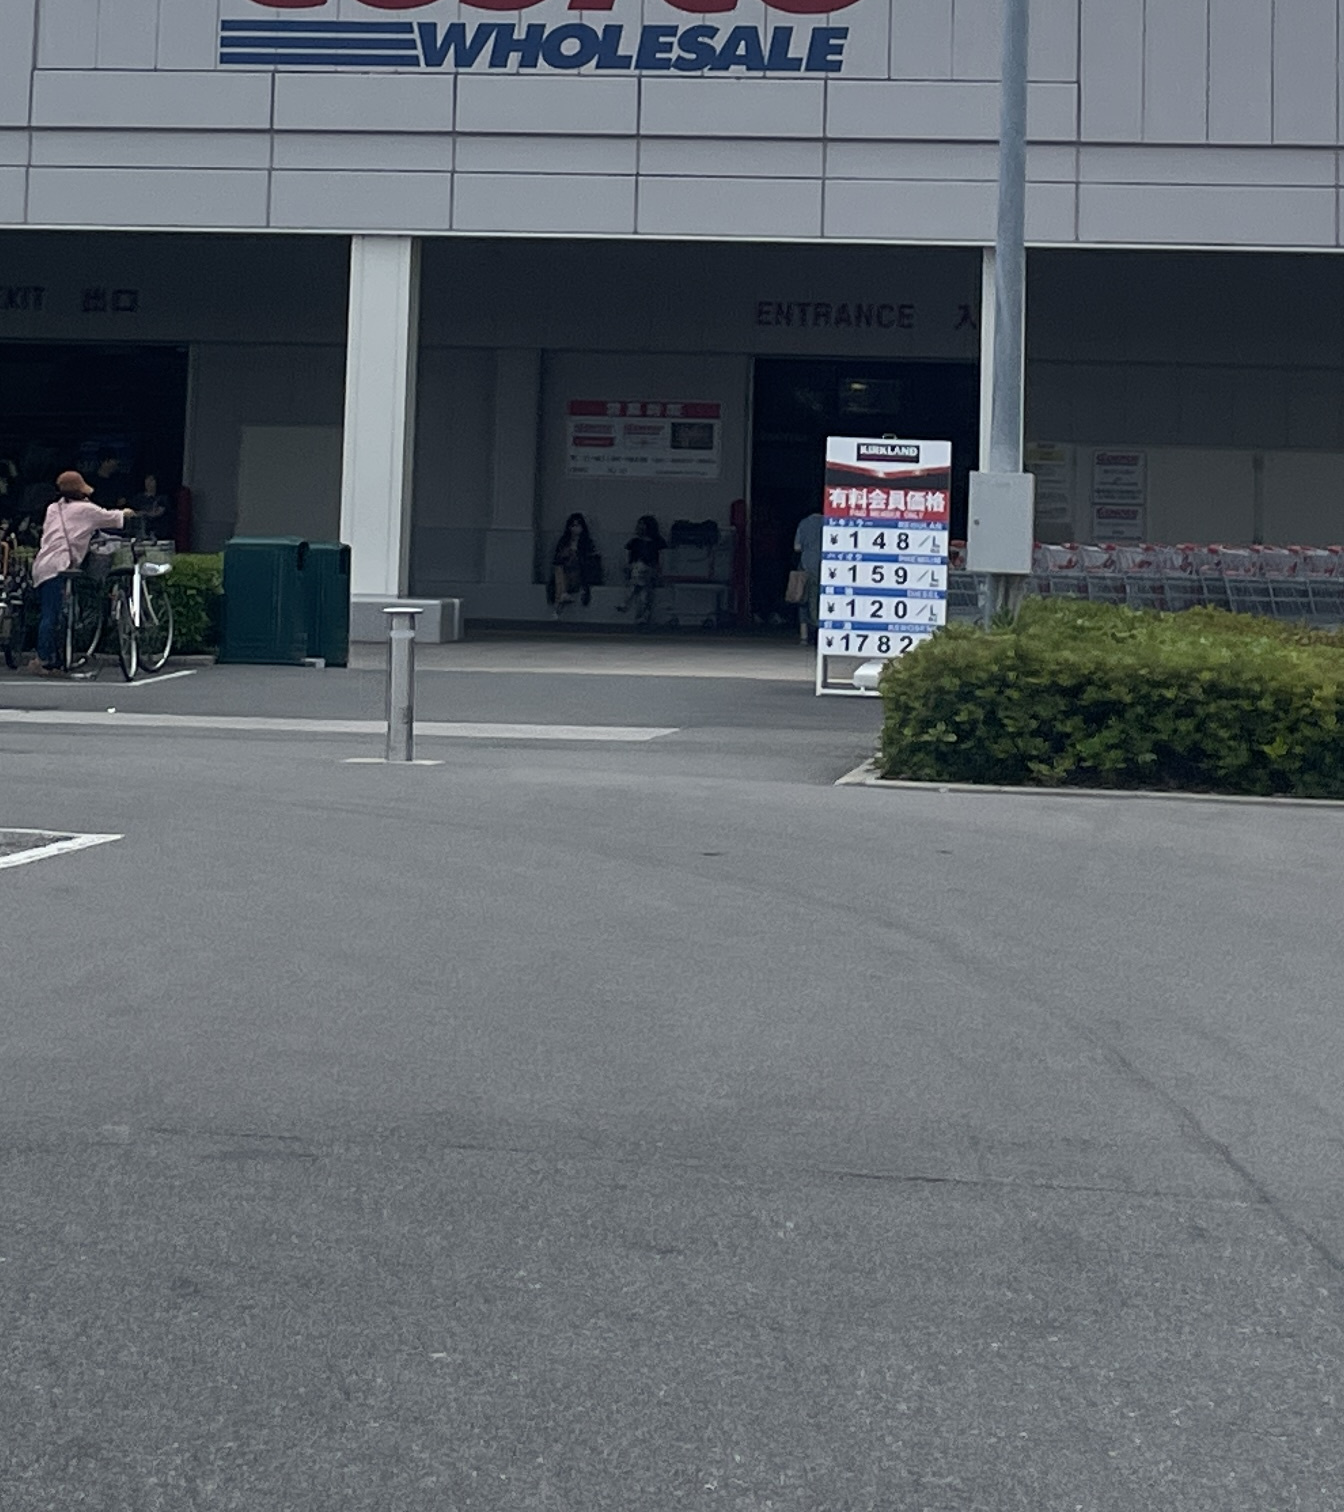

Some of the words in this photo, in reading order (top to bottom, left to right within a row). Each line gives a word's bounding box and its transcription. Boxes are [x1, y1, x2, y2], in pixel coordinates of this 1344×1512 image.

[415, 21, 850, 73] WHOLESALE
[80, 287, 140, 312] 出口
[757, 301, 915, 329] ENTRANCE
[859, 445, 918, 456] KIRKLAND
[829, 488, 945, 512] 有料会員価格
